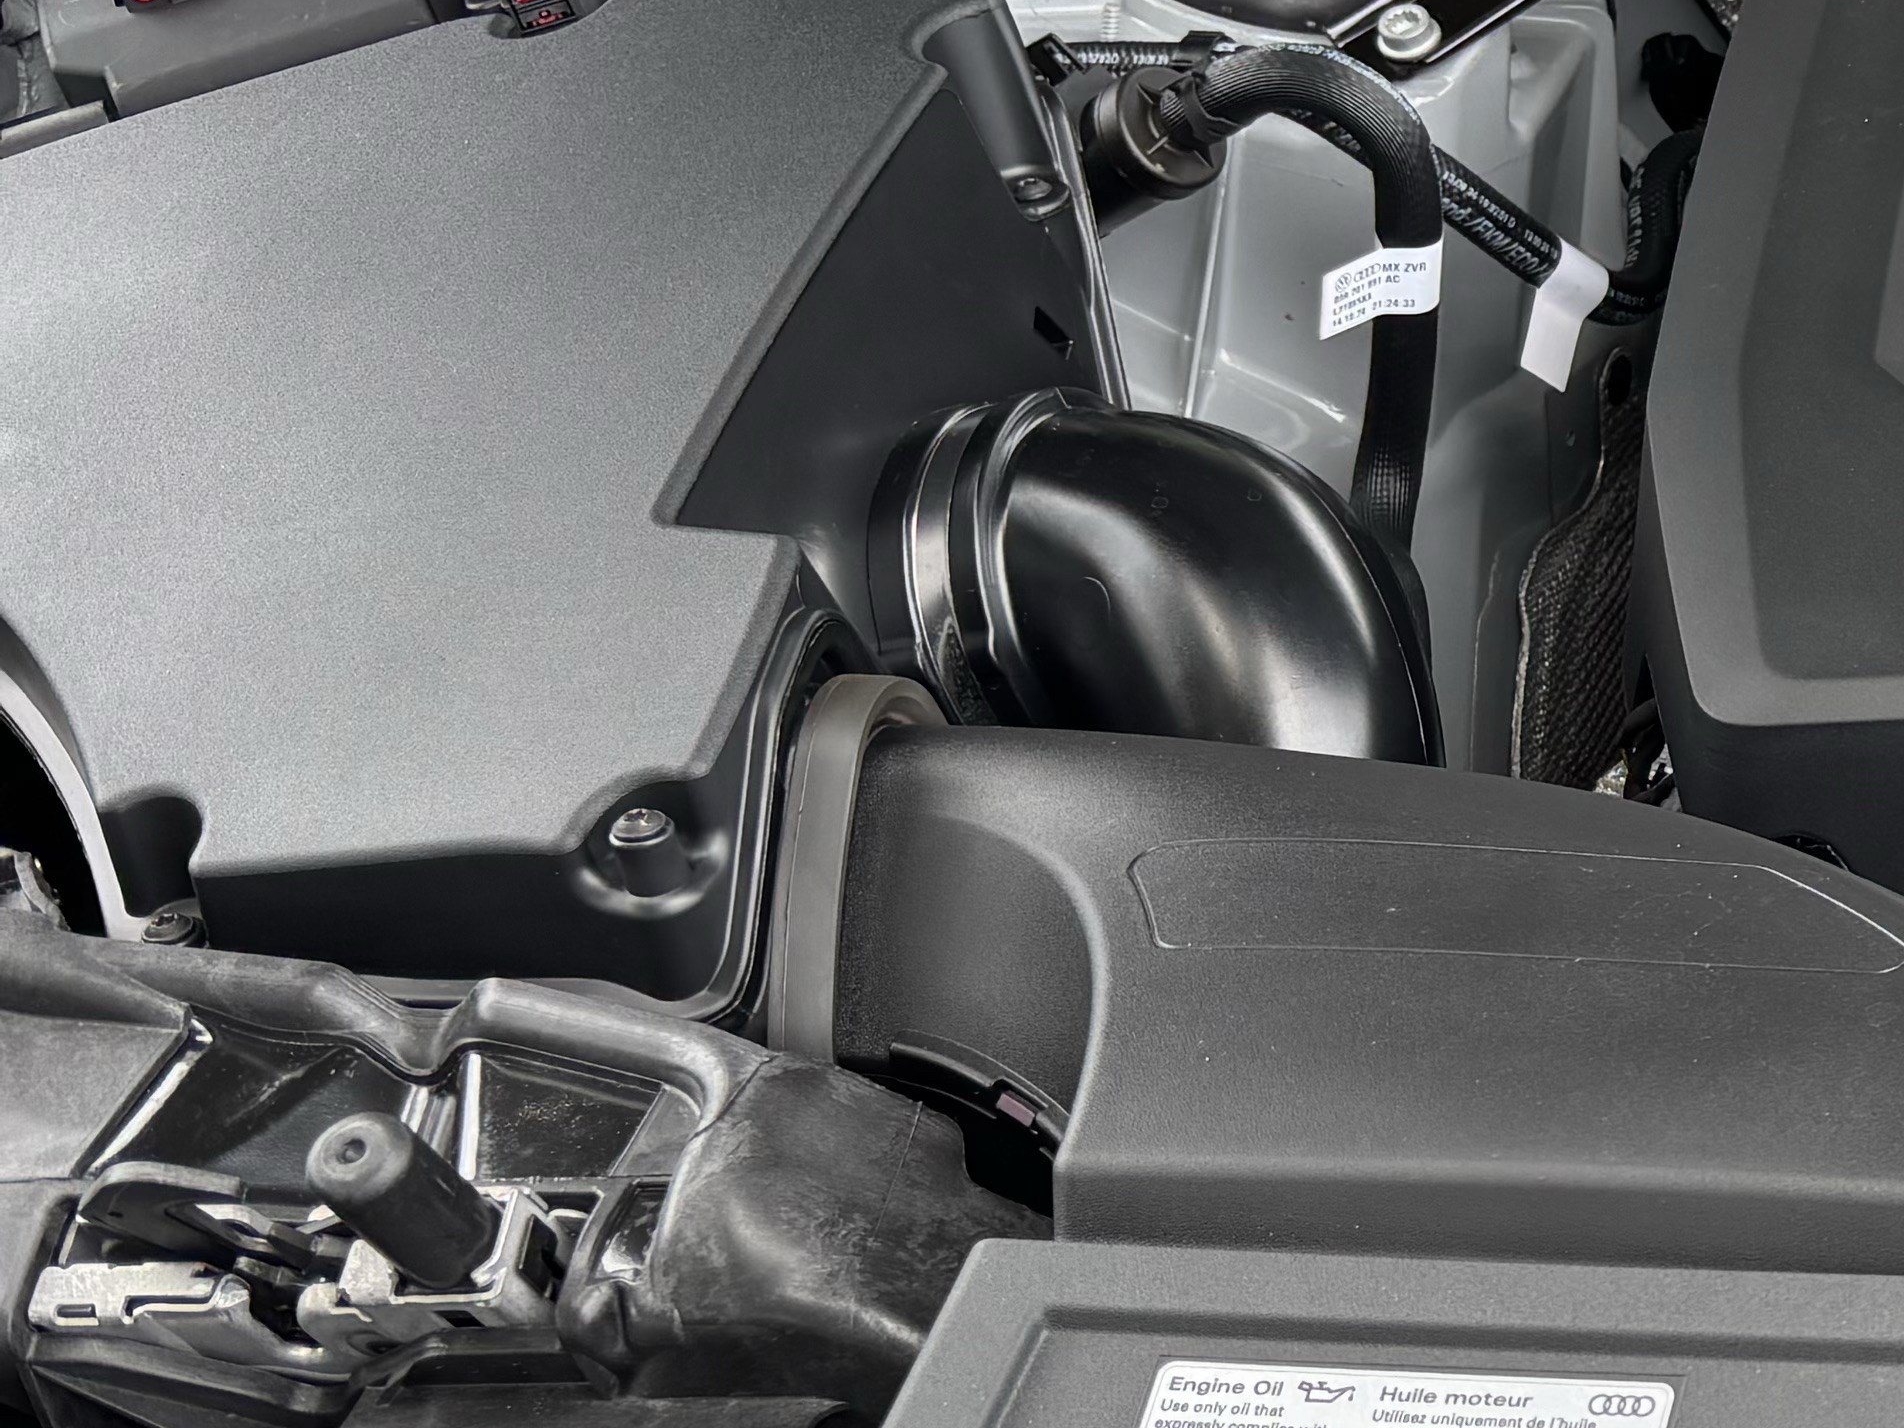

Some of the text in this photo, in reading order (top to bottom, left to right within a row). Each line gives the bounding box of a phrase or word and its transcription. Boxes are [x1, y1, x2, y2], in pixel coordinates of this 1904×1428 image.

[1168, 1375, 1284, 1397] Engine Oil
[1379, 1385, 1534, 1408] Huile moteur
[1160, 1398, 1285, 1418] Use only oil that
[1372, 1408, 1427, 1425] Utilisez
[1430, 1412, 1523, 1428] uniquement
